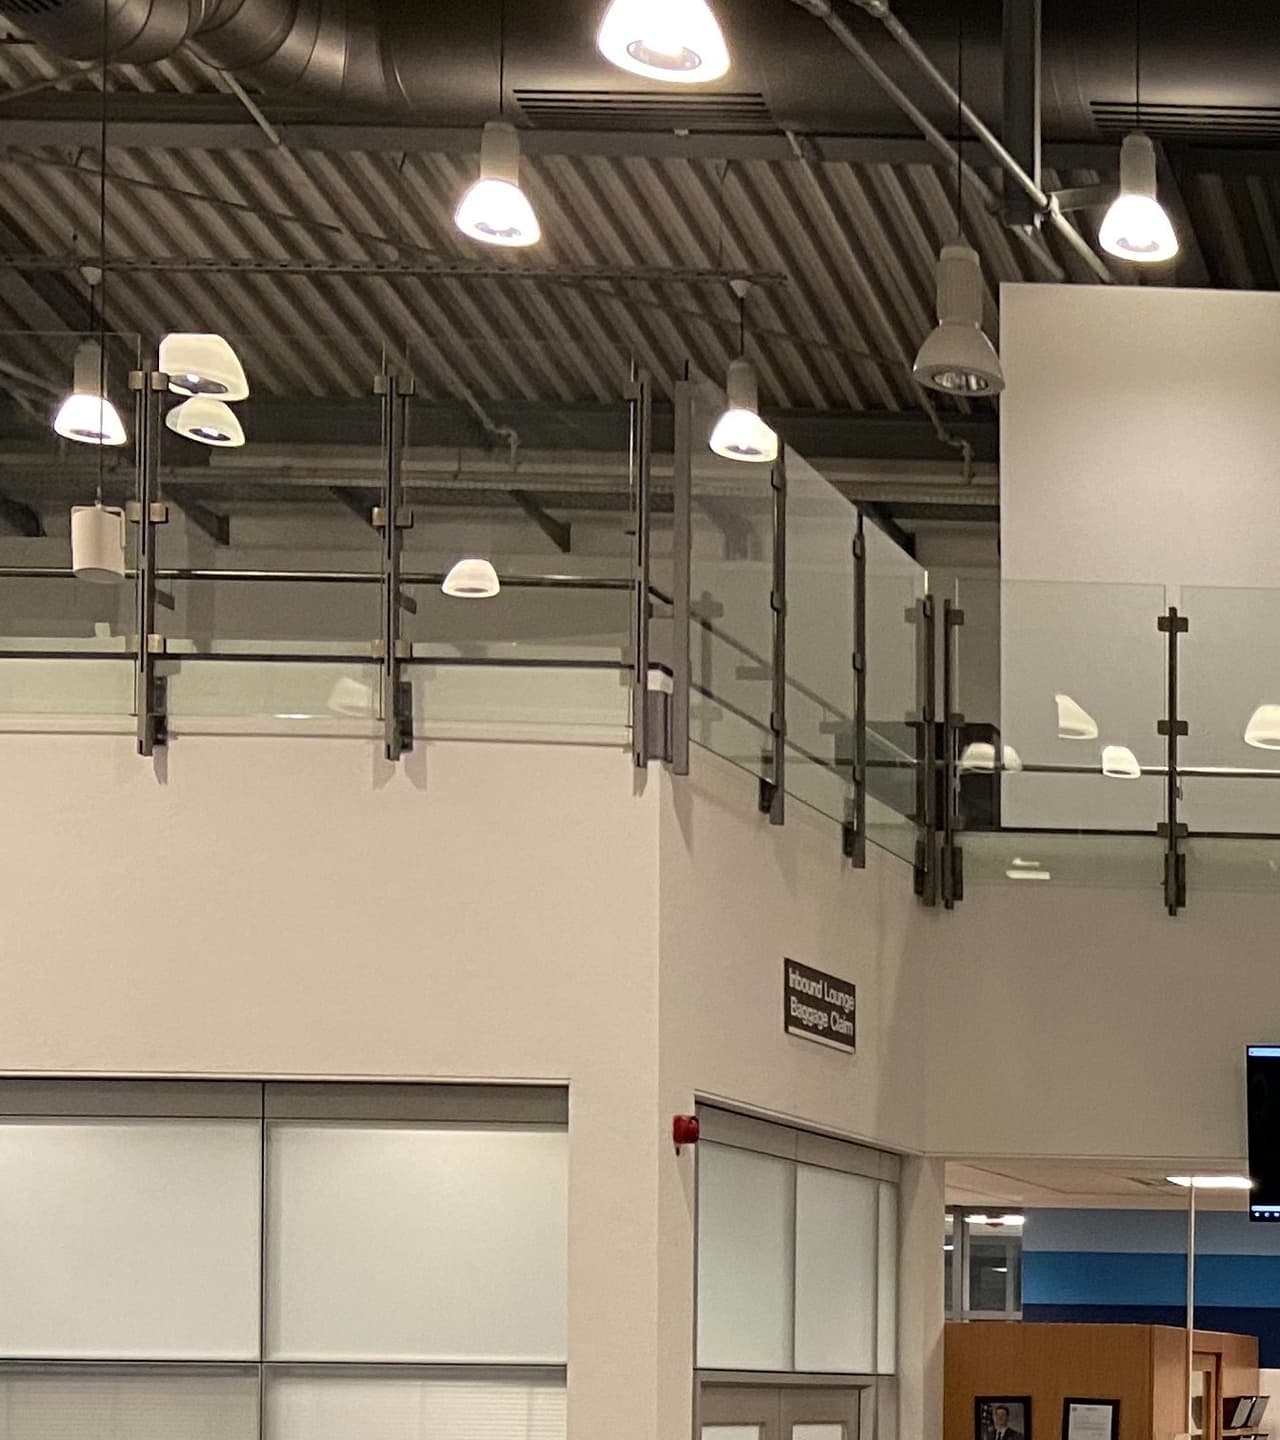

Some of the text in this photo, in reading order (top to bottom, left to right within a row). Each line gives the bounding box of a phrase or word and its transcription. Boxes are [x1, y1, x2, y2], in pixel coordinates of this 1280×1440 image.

[788, 967, 855, 1014] Inbound Lounge
[790, 995, 854, 1037] Baggage Claim
